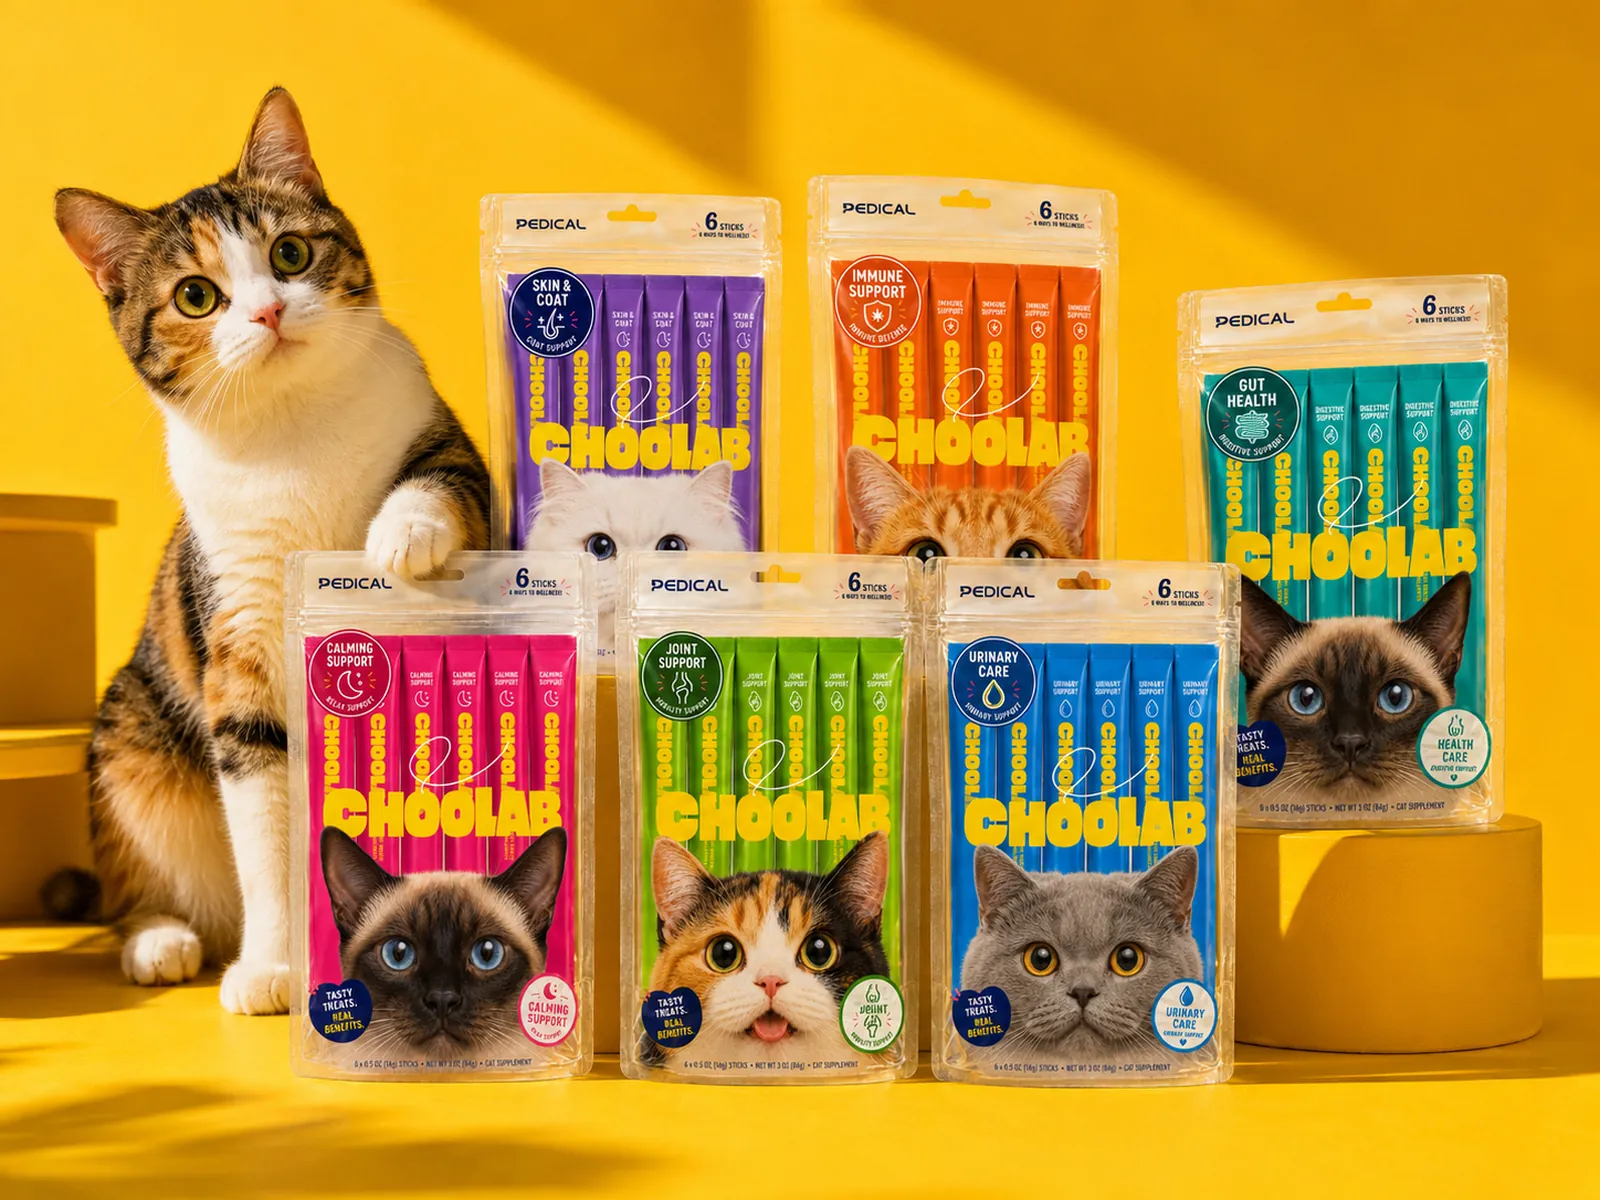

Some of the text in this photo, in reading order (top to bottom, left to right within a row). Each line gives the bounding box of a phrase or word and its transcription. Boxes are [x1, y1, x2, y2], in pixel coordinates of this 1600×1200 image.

[842, 203, 916, 215] PEDICAL
[1040, 201, 1079, 220] 6 STICKS
[516, 219, 586, 229] PEDICAL
[705, 212, 717, 230] 6
[853, 270, 903, 282] IMMUNE
[533, 280, 571, 291] SKIN &
[849, 285, 906, 298] SUPPORT
[537, 294, 568, 306] COAT
[1423, 295, 1436, 315] 6
[1215, 312, 1294, 327] PEDICAL
[1239, 378, 1264, 391] GUT
[1227, 393, 1276, 407] HEALTH
[529, 422, 751, 471] CHOOLAB
[1226, 526, 1477, 581] CHOOLAB
[319, 578, 392, 589] PEDICAL
[516, 568, 529, 588] 6
[848, 572, 861, 592] 6
[652, 580, 728, 591] PEDICAL
[1158, 578, 1171, 598] 6
[960, 586, 1035, 598] PEDICAL
[327, 643, 373, 654] CALMING
[666, 644, 697, 655] JOINT
[327, 656, 373, 667] SUPPORT
[659, 657, 706, 668] SUPPORT
[969, 651, 1018, 663] URINARY
[978, 666, 1009, 677] CARE
[1237, 741, 1269, 753] REATS.
[1438, 739, 1473, 749] HEALTH
[1442, 752, 1468, 762] CARE
[323, 787, 562, 838] CHOOLAB
[656, 790, 891, 842] CHOOLAB
[964, 796, 1206, 847] CHOOLAB
[326, 988, 352, 1000] TASTY
[968, 995, 992, 1006] TASTY
[528, 1014, 567, 1027] SUPPORT
[1173, 1019, 1196, 1029] CARE
